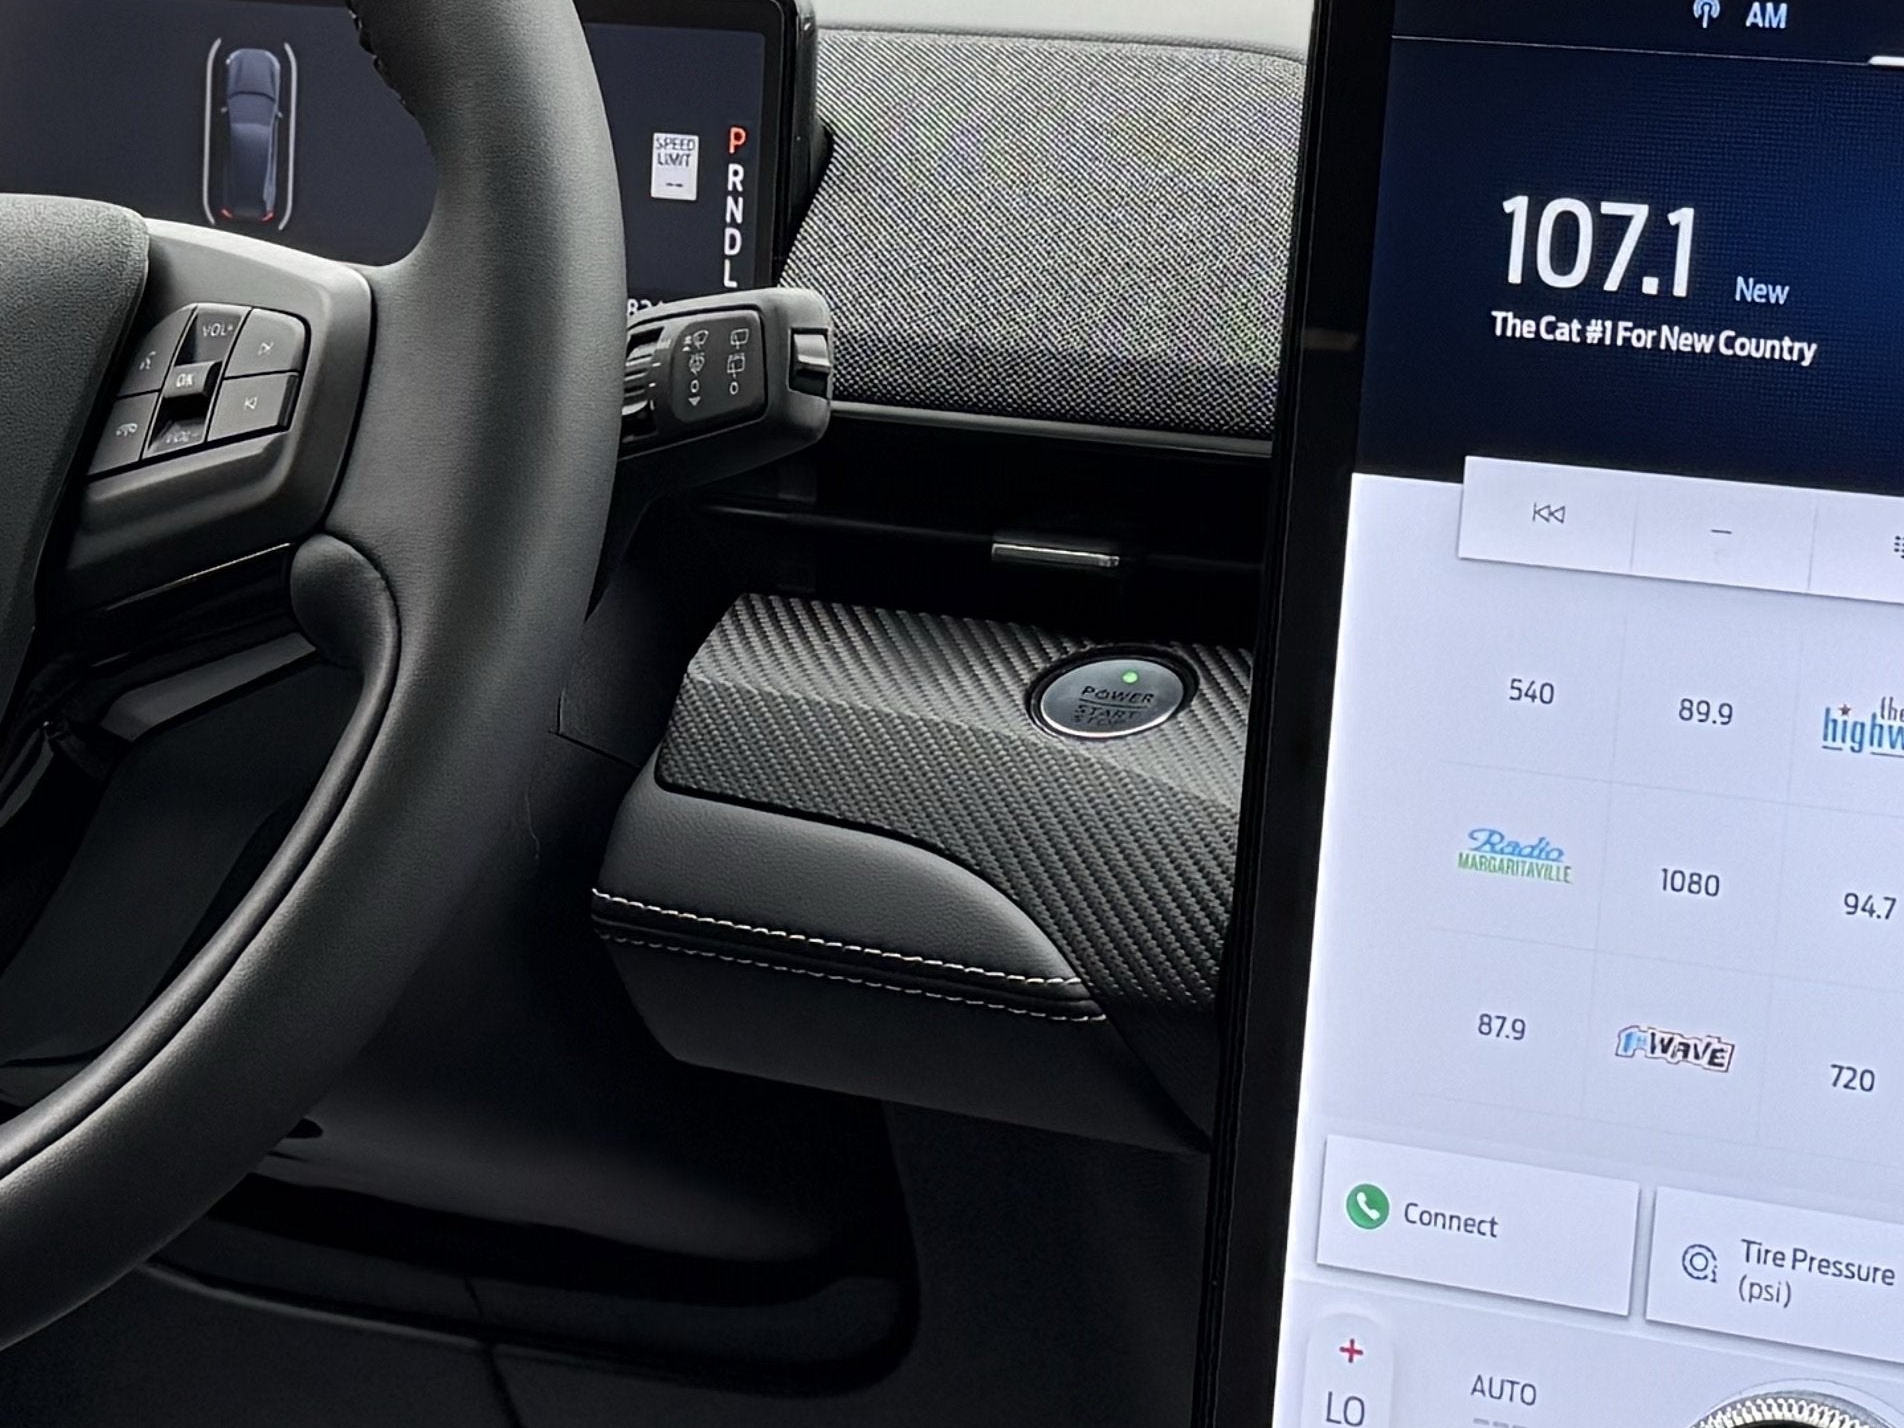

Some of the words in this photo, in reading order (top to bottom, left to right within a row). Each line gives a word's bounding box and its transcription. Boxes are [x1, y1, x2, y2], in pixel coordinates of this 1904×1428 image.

[1745, 0, 1788, 30] AM
[654, 136, 696, 153] SPEED
[727, 126, 747, 155] P
[656, 153, 692, 168] LIMIT
[727, 163, 745, 193] R
[725, 196, 744, 224] N
[723, 227, 742, 257] D
[1501, 194, 1696, 300] 107.1
[1734, 275, 1790, 306] New
[723, 260, 739, 288] L
[1490, 310, 1537, 340] The
[1539, 314, 1582, 344] Cat
[1585, 319, 1613, 346] #1
[1616, 321, 1658, 350] For
[1659, 325, 1715, 355] New
[1718, 330, 1818, 368] Country
[1080, 685, 1155, 703] POWER
[1506, 677, 1557, 708] 540
[1076, 704, 1137, 719] START
[1678, 697, 1735, 728] 89.9
[1467, 828, 1564, 863] Radio
[1457, 851, 1574, 884] MARGARITAVILLE
[1659, 867, 1721, 898] 1080
[1842, 891, 1897, 922] 94.7
[1477, 1013, 1527, 1043] 87.9
[1828, 1063, 1877, 1096] 720
[1403, 1201, 1500, 1241] Connect
[1740, 1238, 1786, 1269] Tire
[1791, 1247, 1897, 1288] Pressure
[1737, 1275, 1794, 1310] (psi)
[1470, 1373, 1538, 1408] AUTO
[1325, 1390, 1367, 1428] LO
